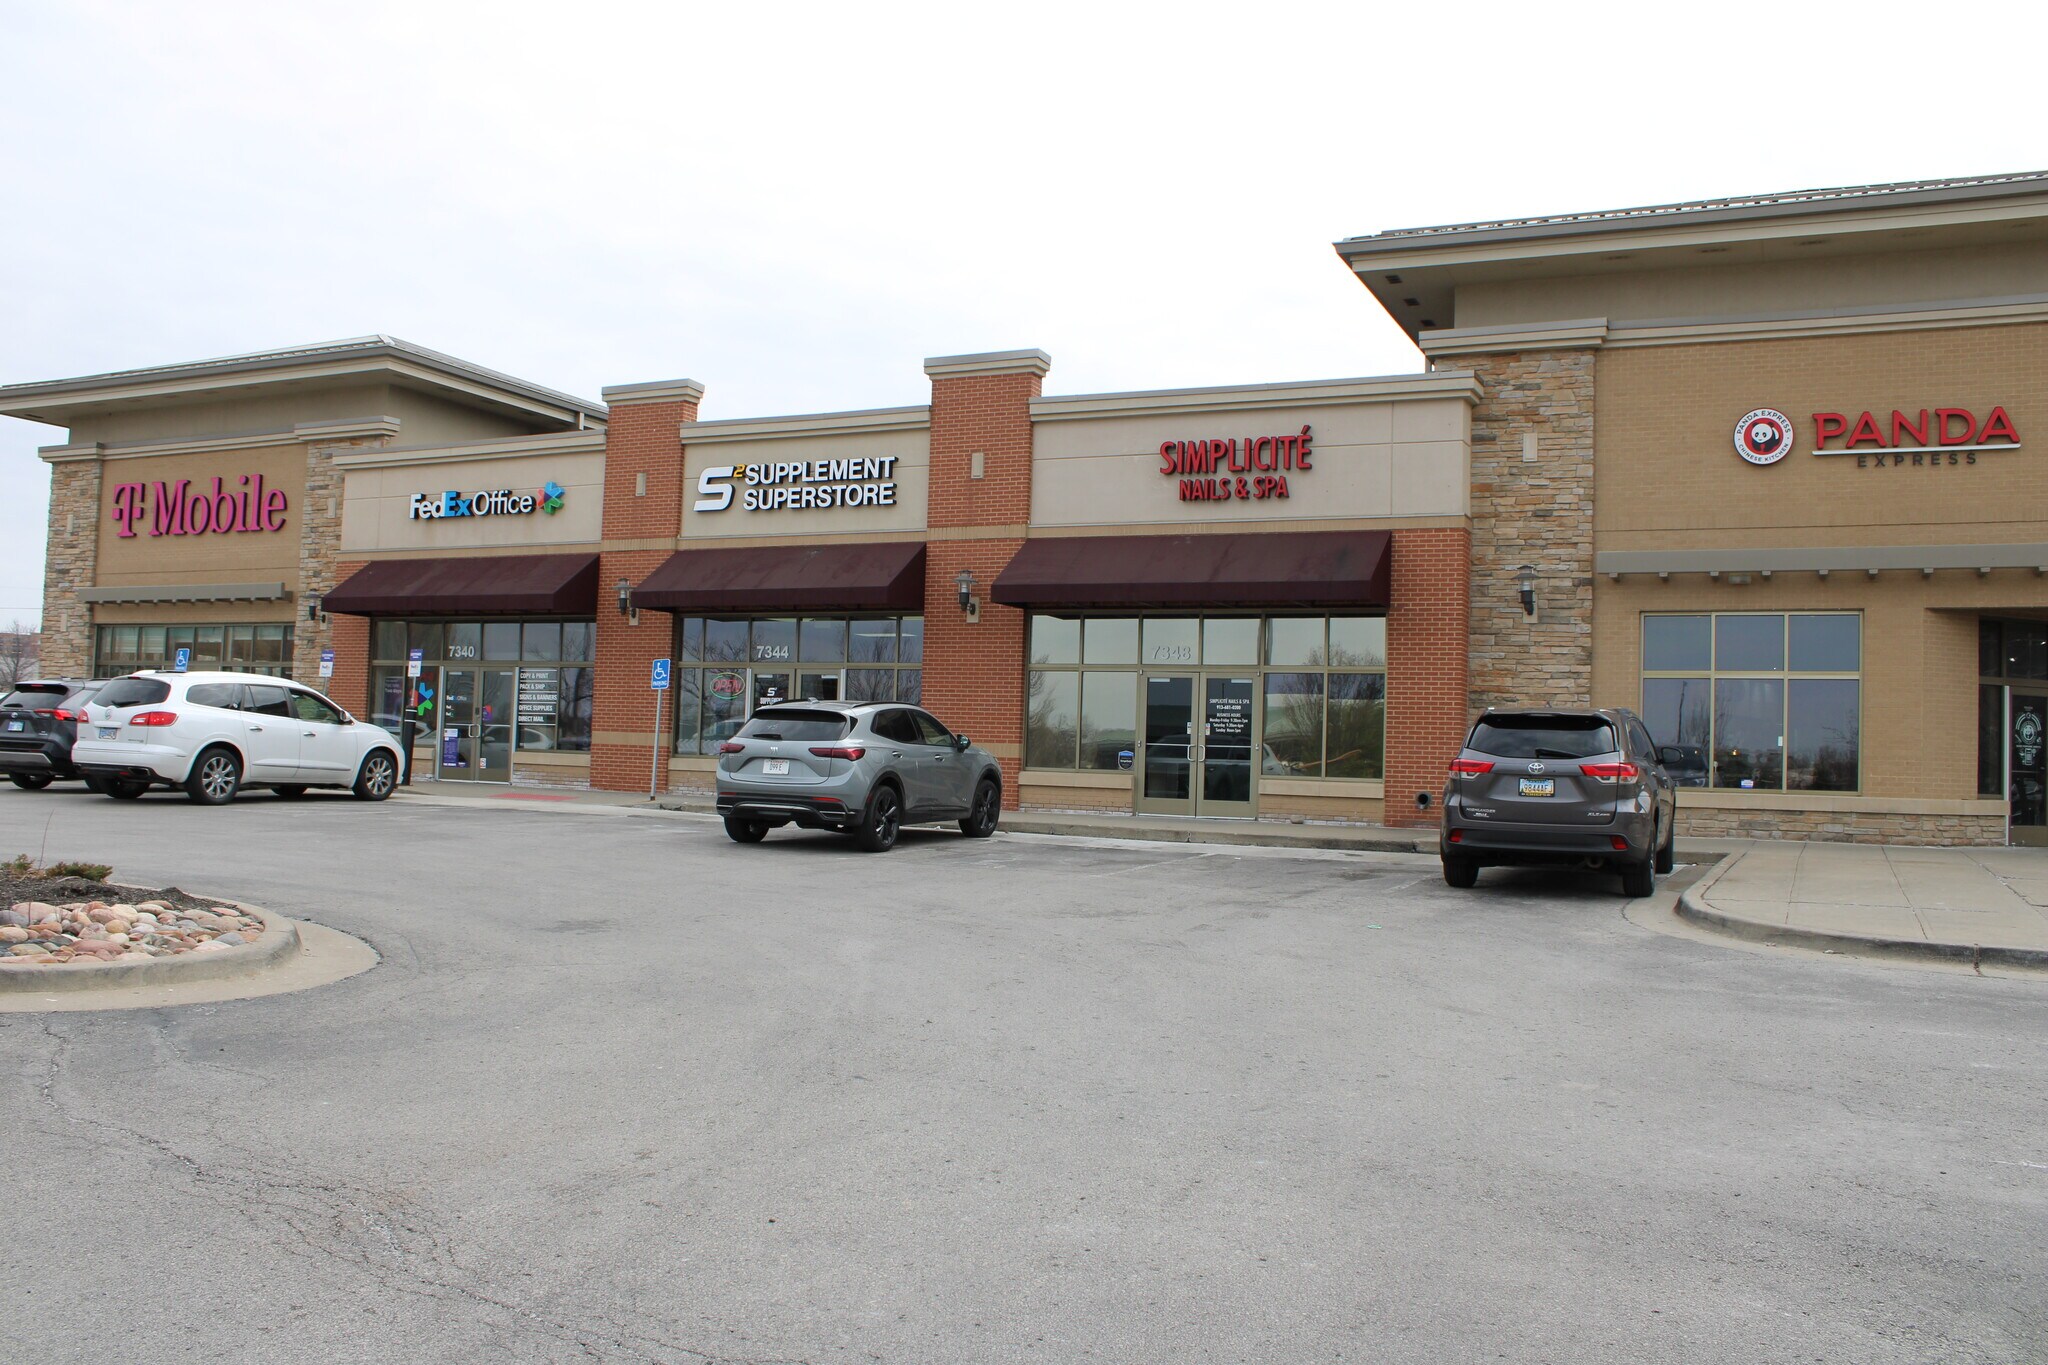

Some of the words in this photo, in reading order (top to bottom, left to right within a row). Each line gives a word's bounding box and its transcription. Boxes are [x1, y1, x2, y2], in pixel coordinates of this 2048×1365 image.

[1737, 412, 1759, 435] PANDA
[1761, 410, 1791, 433] EXPRESS
[1812, 406, 2020, 449] PANDA
[1160, 424, 1313, 475] SIMPLICITÉ
[1738, 443, 1762, 462] CHINESE
[1764, 443, 1789, 462] KITCHEN
[1857, 452, 1977, 468] EXPRESS
[744, 456, 898, 486] SUPPLEMENT
[742, 482, 898, 512] SUPERSTORE
[1179, 478, 1231, 501] NAILS
[1234, 477, 1249, 499] &
[1253, 475, 1289, 499] SPA
[149, 474, 287, 536] Mobile
[448, 645, 475, 658] 7340
[756, 645, 789, 659] 7344
[1152, 645, 1192, 660] 7348
[713, 679, 742, 693] OPEN
